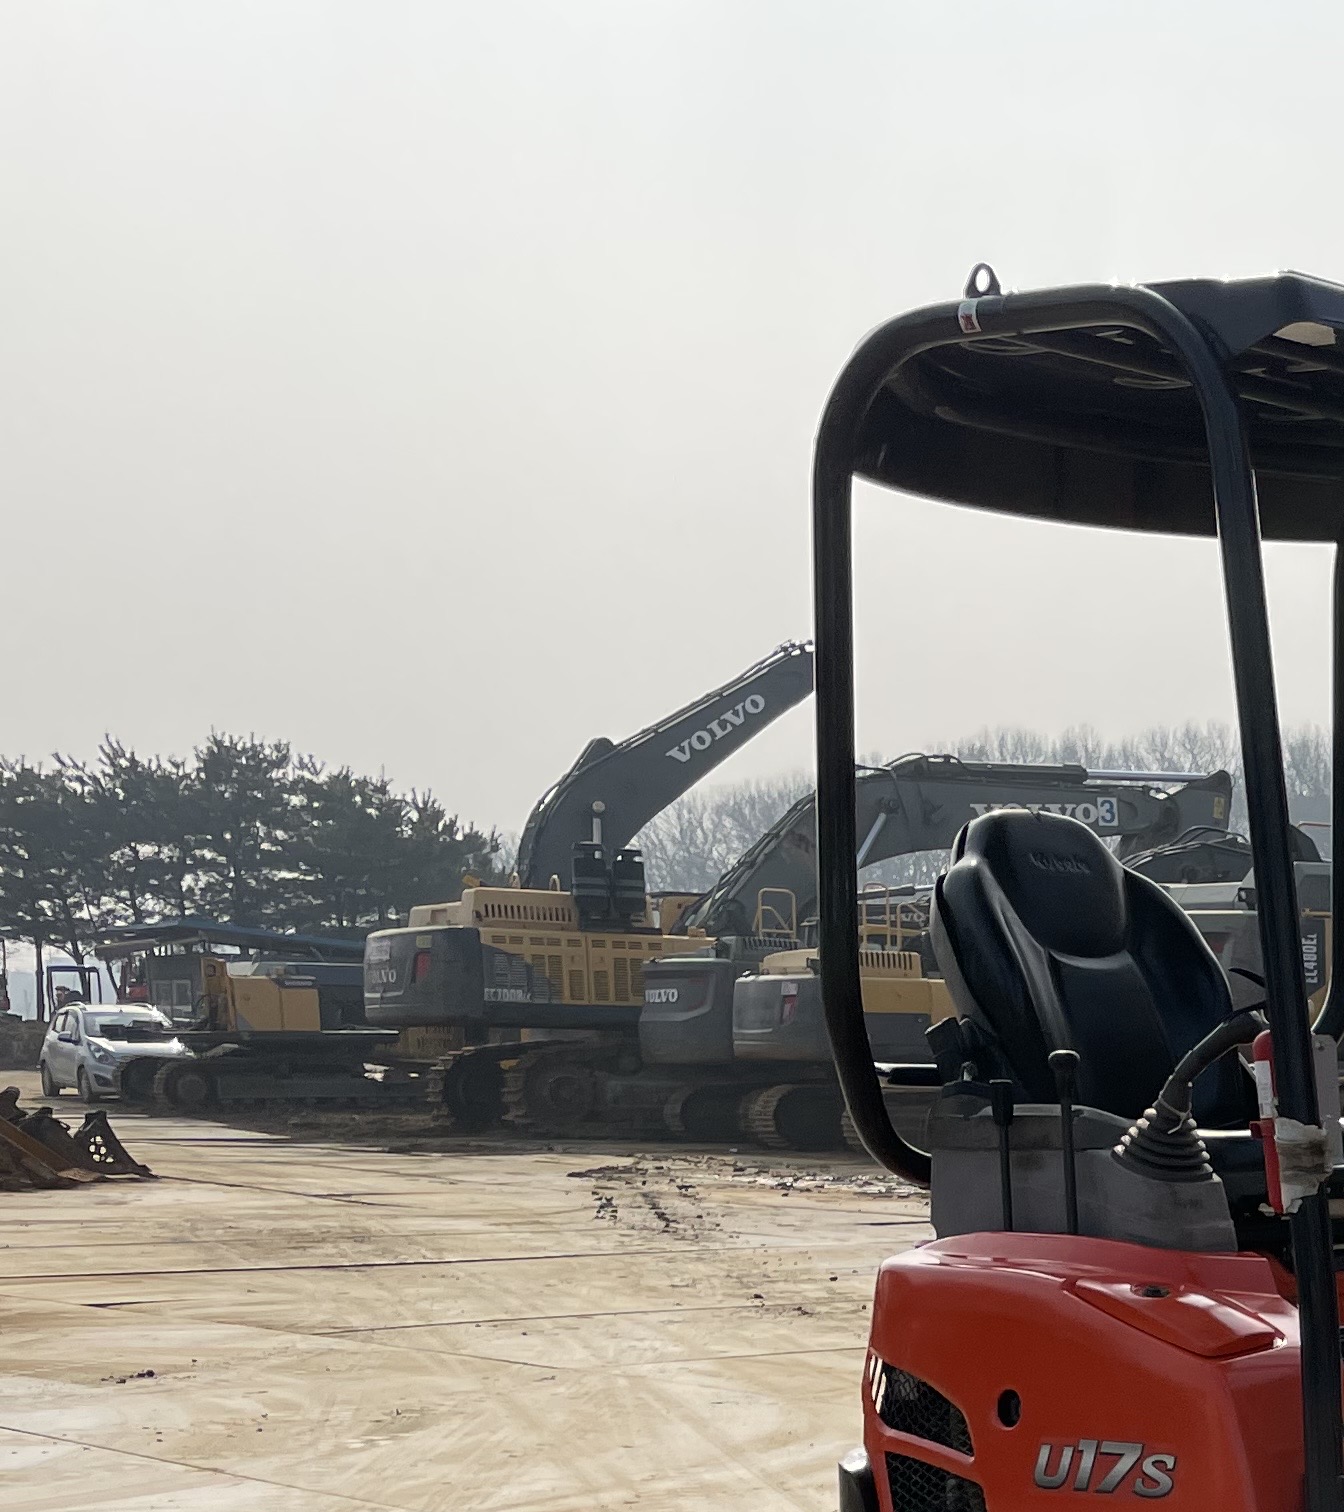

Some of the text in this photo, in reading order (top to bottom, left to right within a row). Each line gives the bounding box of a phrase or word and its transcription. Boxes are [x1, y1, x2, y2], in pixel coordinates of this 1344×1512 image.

[665, 694, 765, 763] VOLVO
[1100, 800, 1116, 824] 3
[1034, 1438, 1176, 1498] U17S
